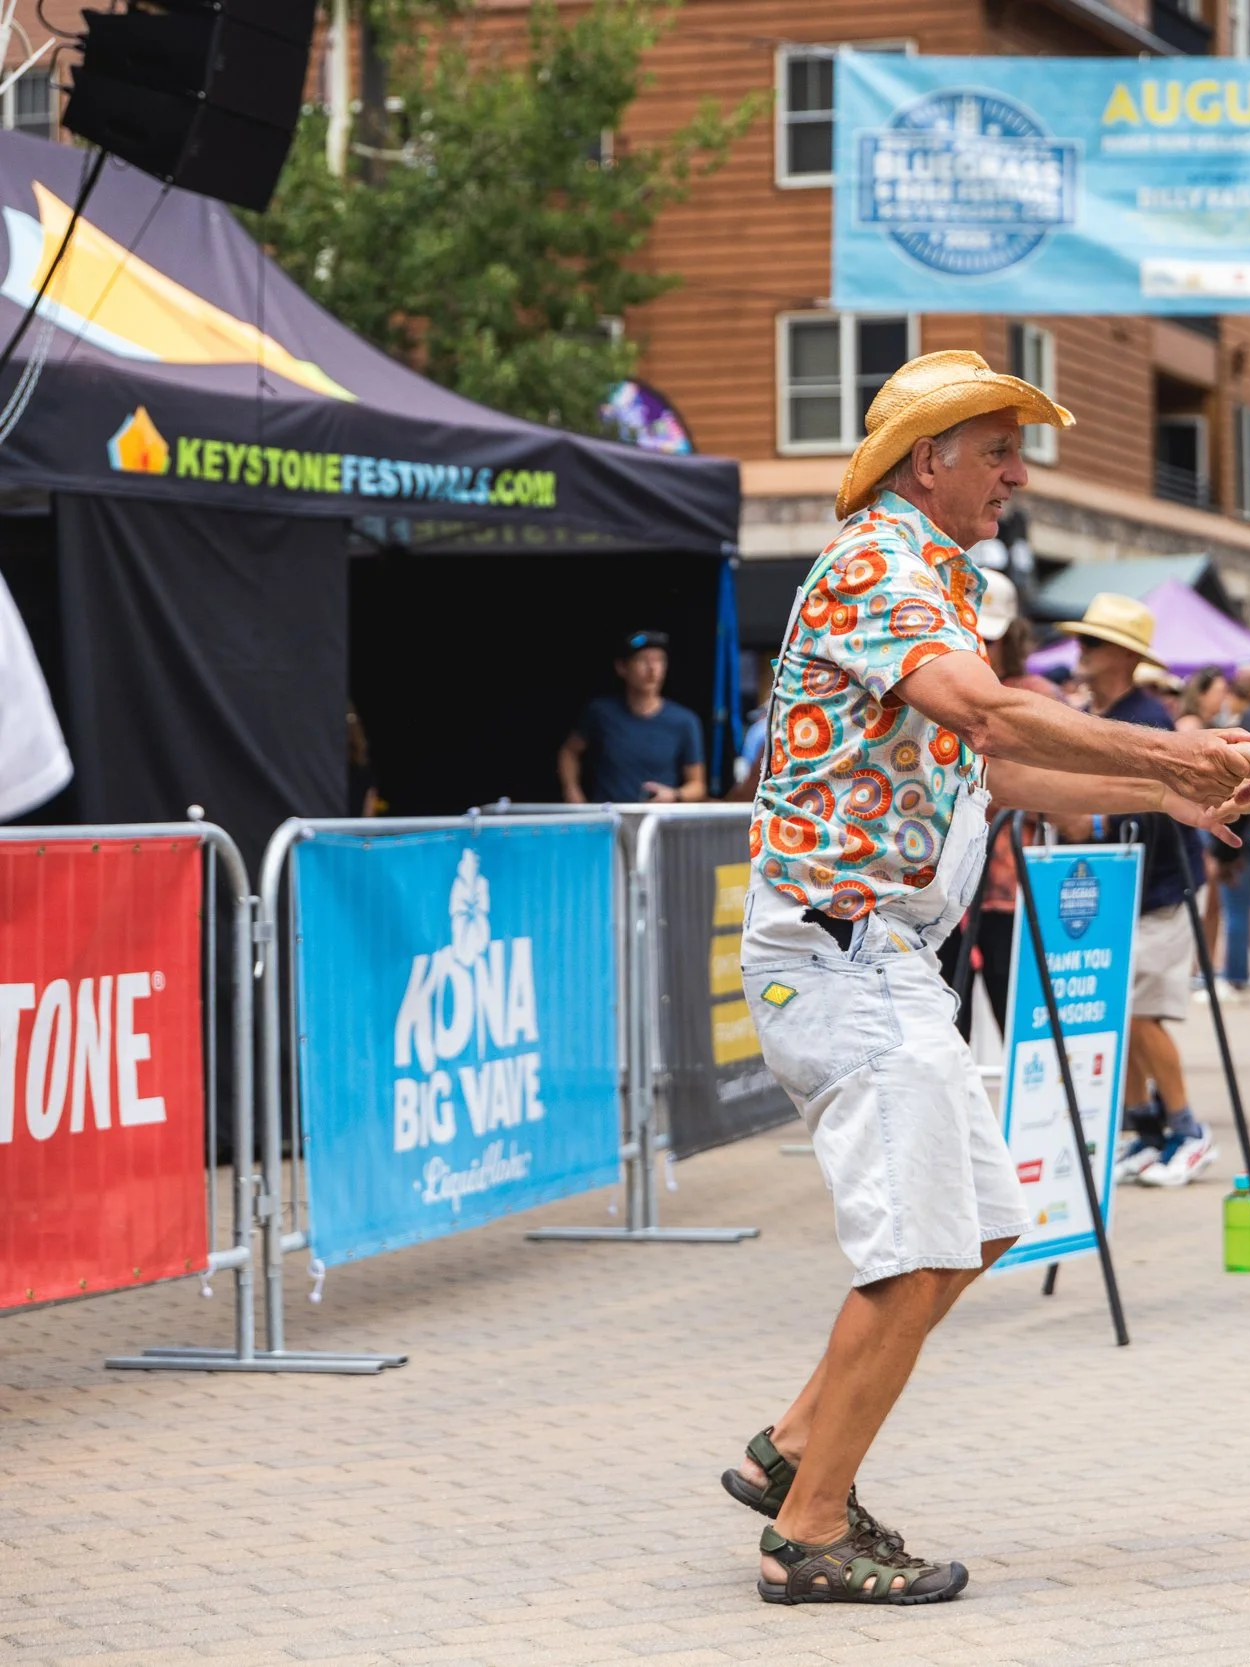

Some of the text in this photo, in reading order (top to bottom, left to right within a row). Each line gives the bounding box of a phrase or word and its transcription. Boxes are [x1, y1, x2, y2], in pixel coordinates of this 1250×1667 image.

[1045, 947, 1113, 973] HANK YOU
[1067, 974, 1097, 998] OUR
[394, 935, 539, 1074] KONA
[1031, 1000, 1107, 1029] SPNSORS!
[393, 1069, 457, 1153] BIG
